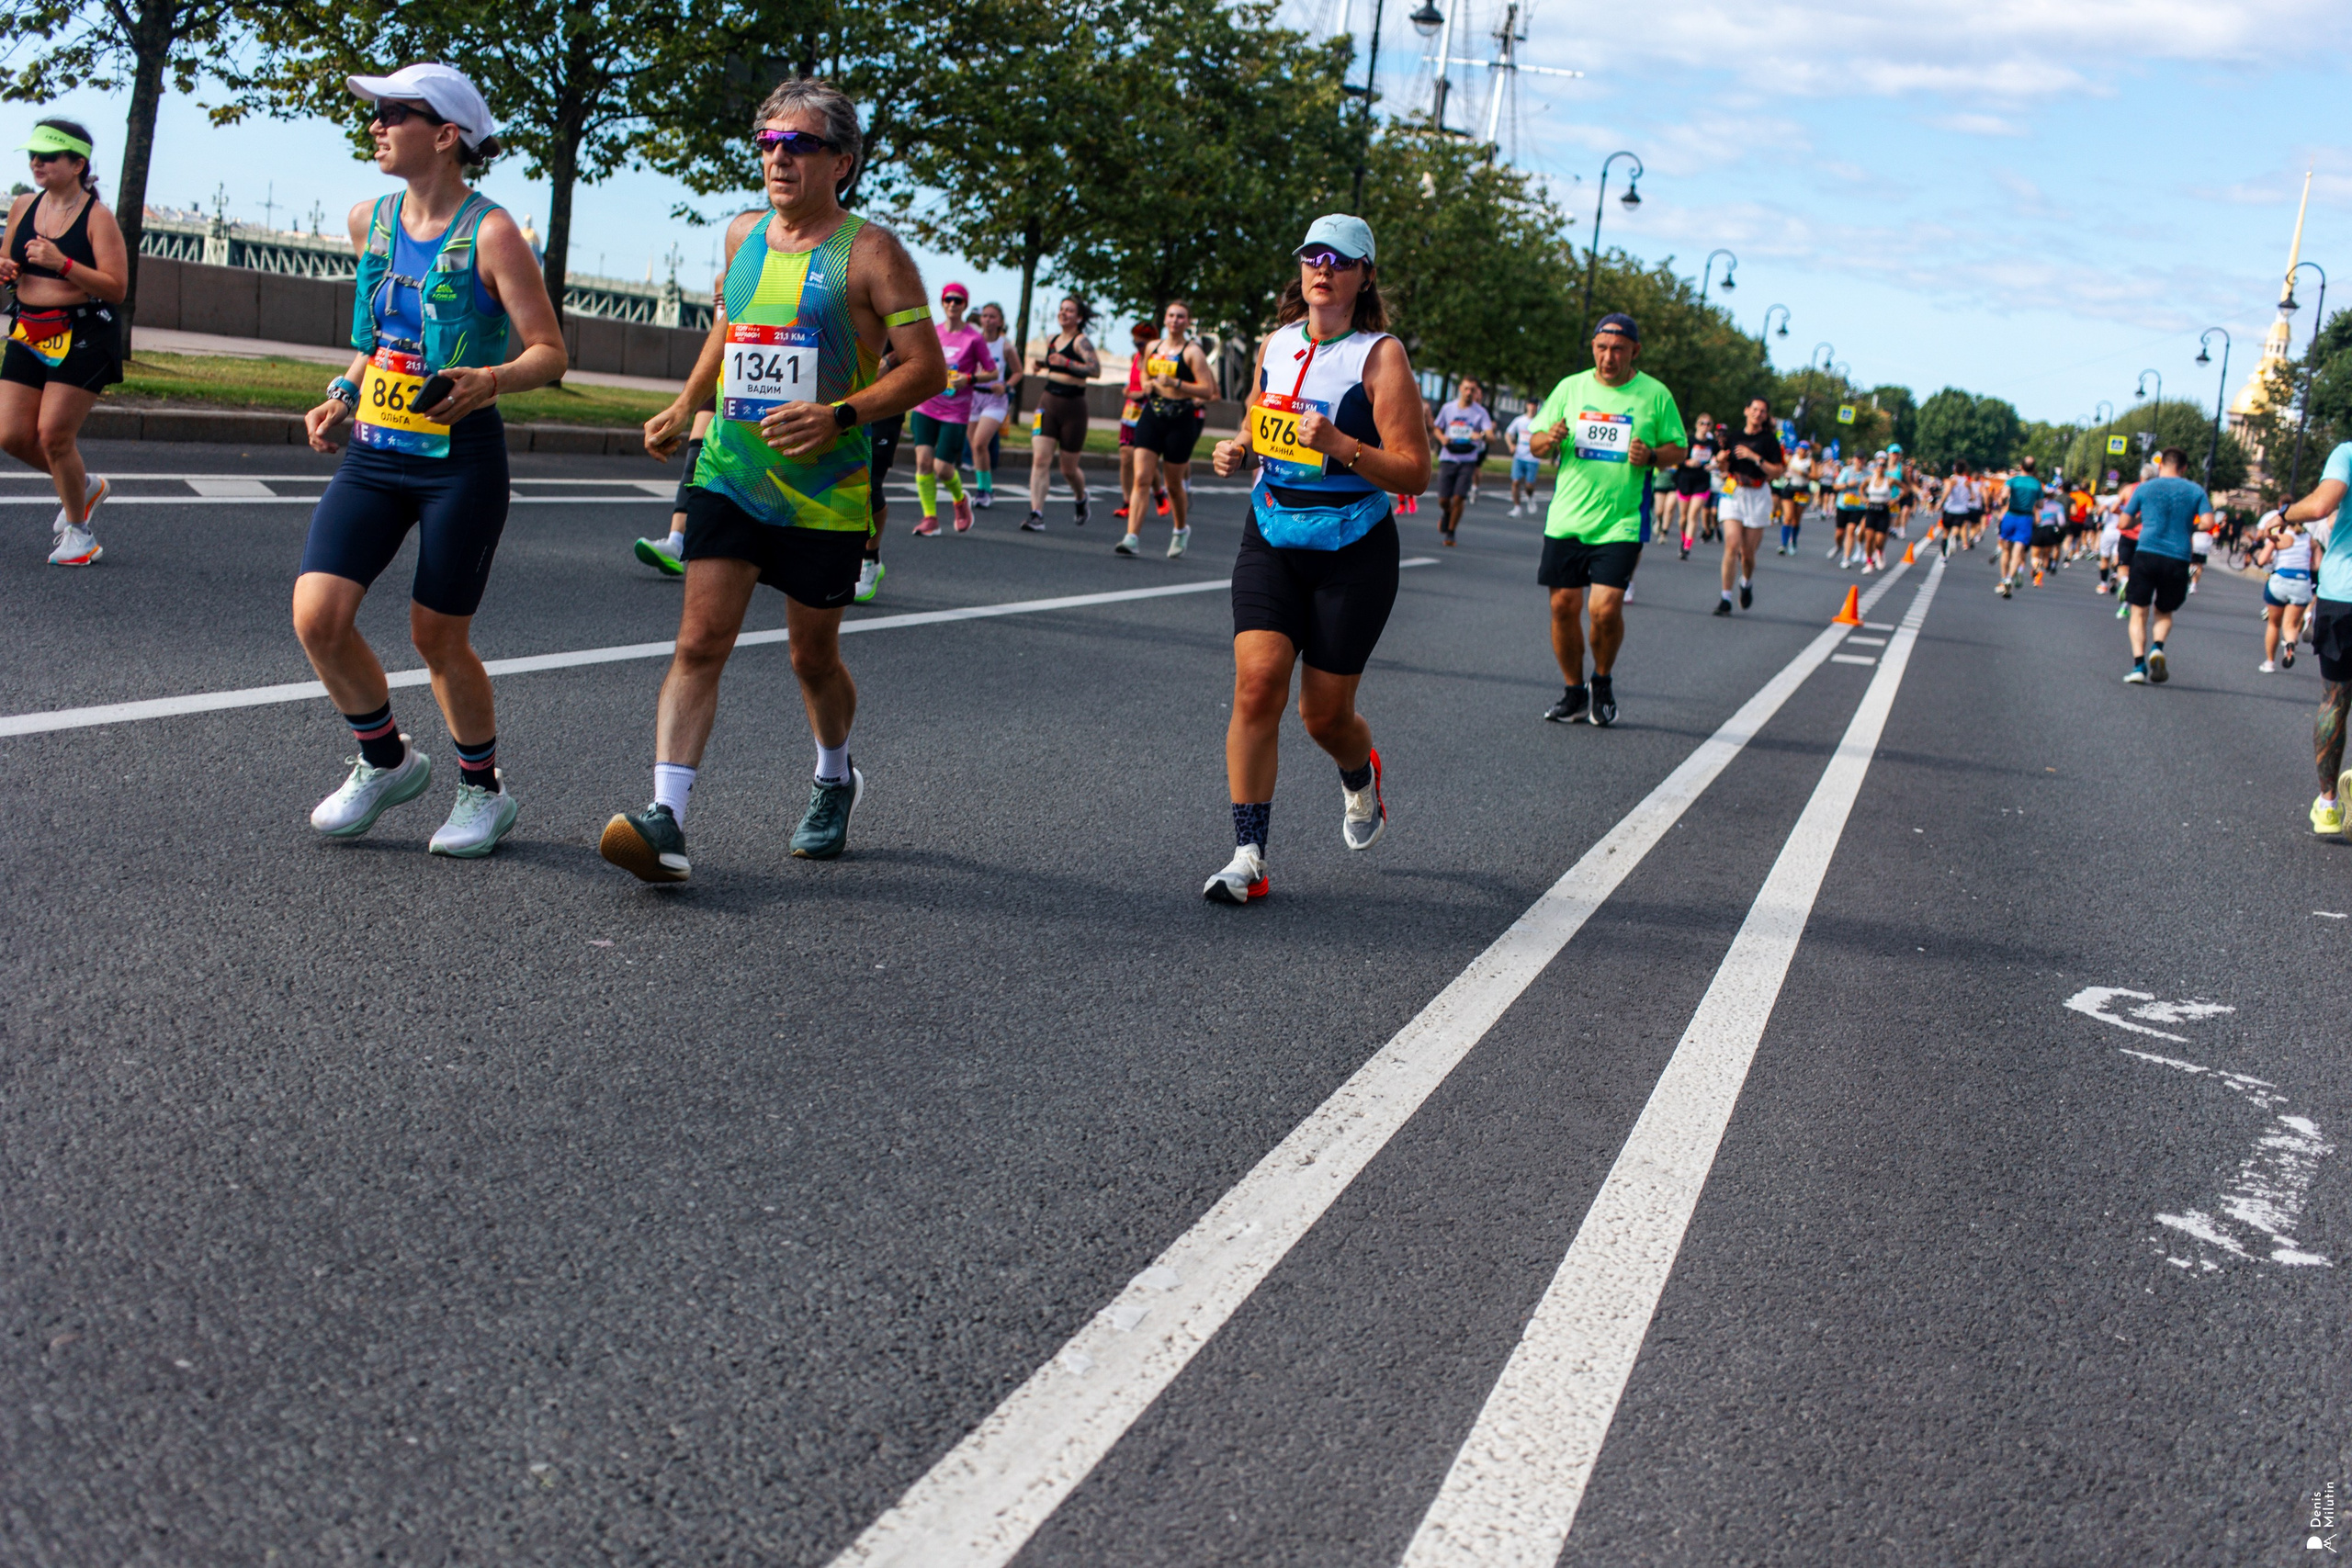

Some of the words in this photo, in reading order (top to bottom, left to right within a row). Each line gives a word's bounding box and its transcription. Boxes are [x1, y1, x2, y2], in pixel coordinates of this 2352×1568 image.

[28, 333, 63, 350] 50
[774, 331, 789, 341] 21,1
[790, 333, 806, 342] КМ
[405, 360, 422, 371] 21,1
[733, 351, 799, 384] 1341
[747, 384, 782, 395] ВАДИМ
[728, 400, 736, 417] E
[1291, 400, 1305, 411] 21,1
[380, 412, 412, 425] ОЛЬГА
[360, 423, 369, 442] E
[1260, 415, 1309, 448] 676
[1588, 425, 1618, 442] 898
[1269, 445, 1295, 457] ЖАННА
